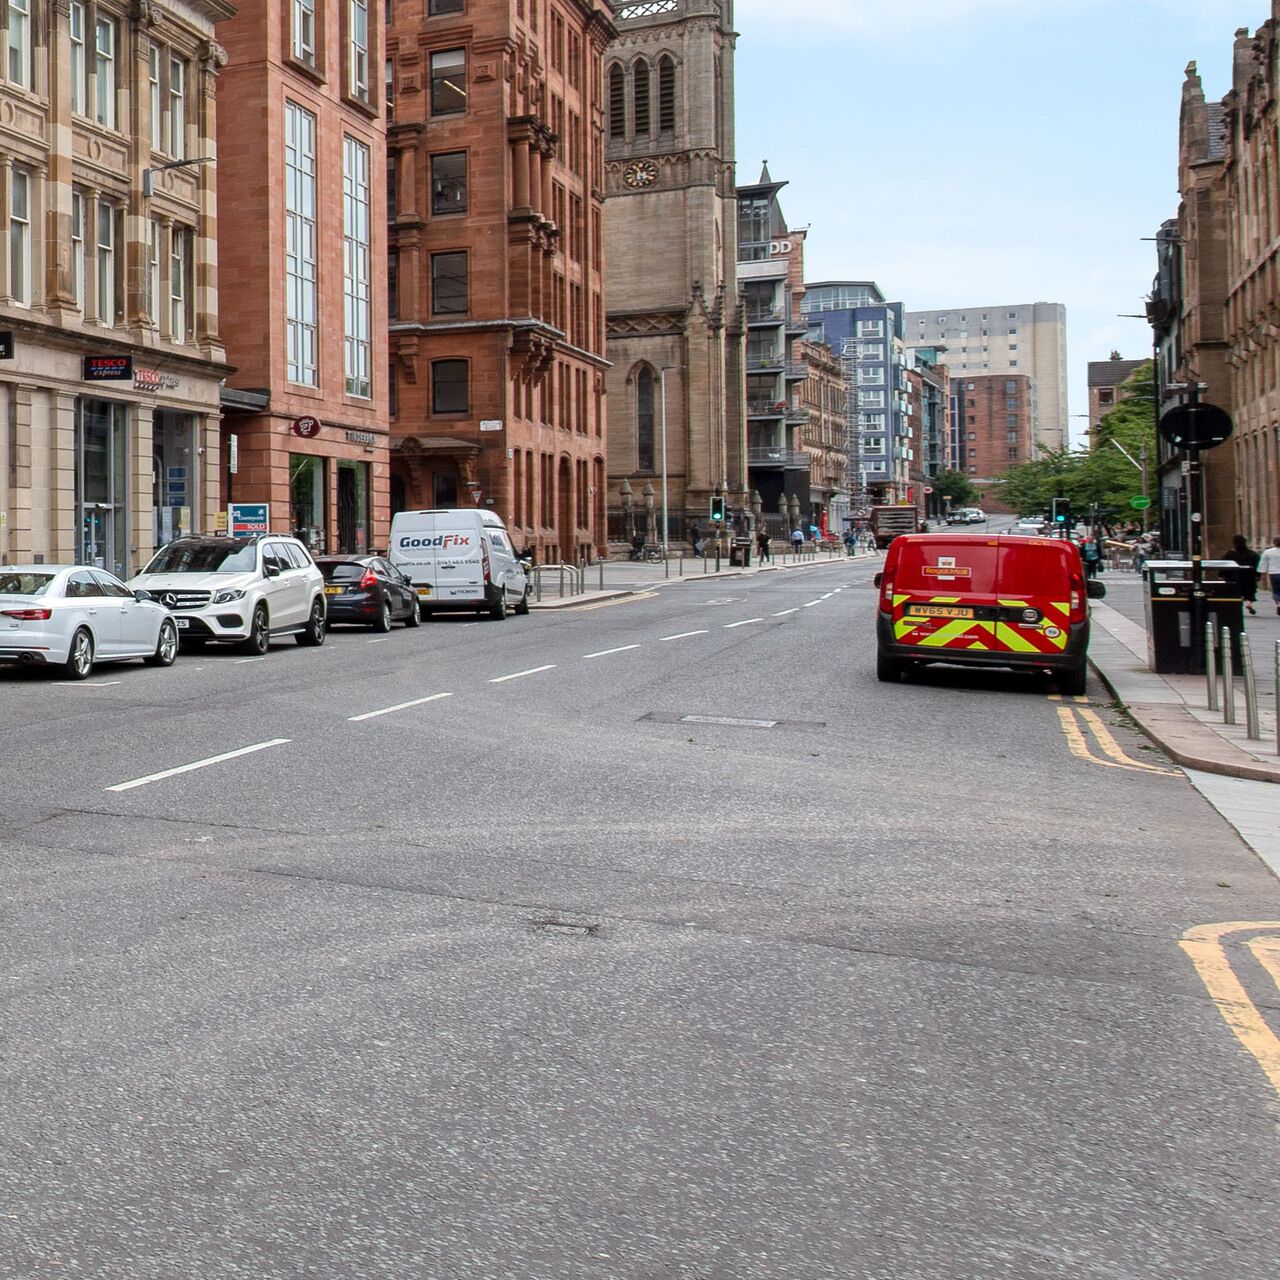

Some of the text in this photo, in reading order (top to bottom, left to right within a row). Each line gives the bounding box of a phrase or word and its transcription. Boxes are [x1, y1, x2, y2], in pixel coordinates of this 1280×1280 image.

[90, 359, 127, 367] TESCO
[93, 369, 122, 377] express
[400, 535, 470, 550] GoodFix
[947, 608, 969, 617] VJU
